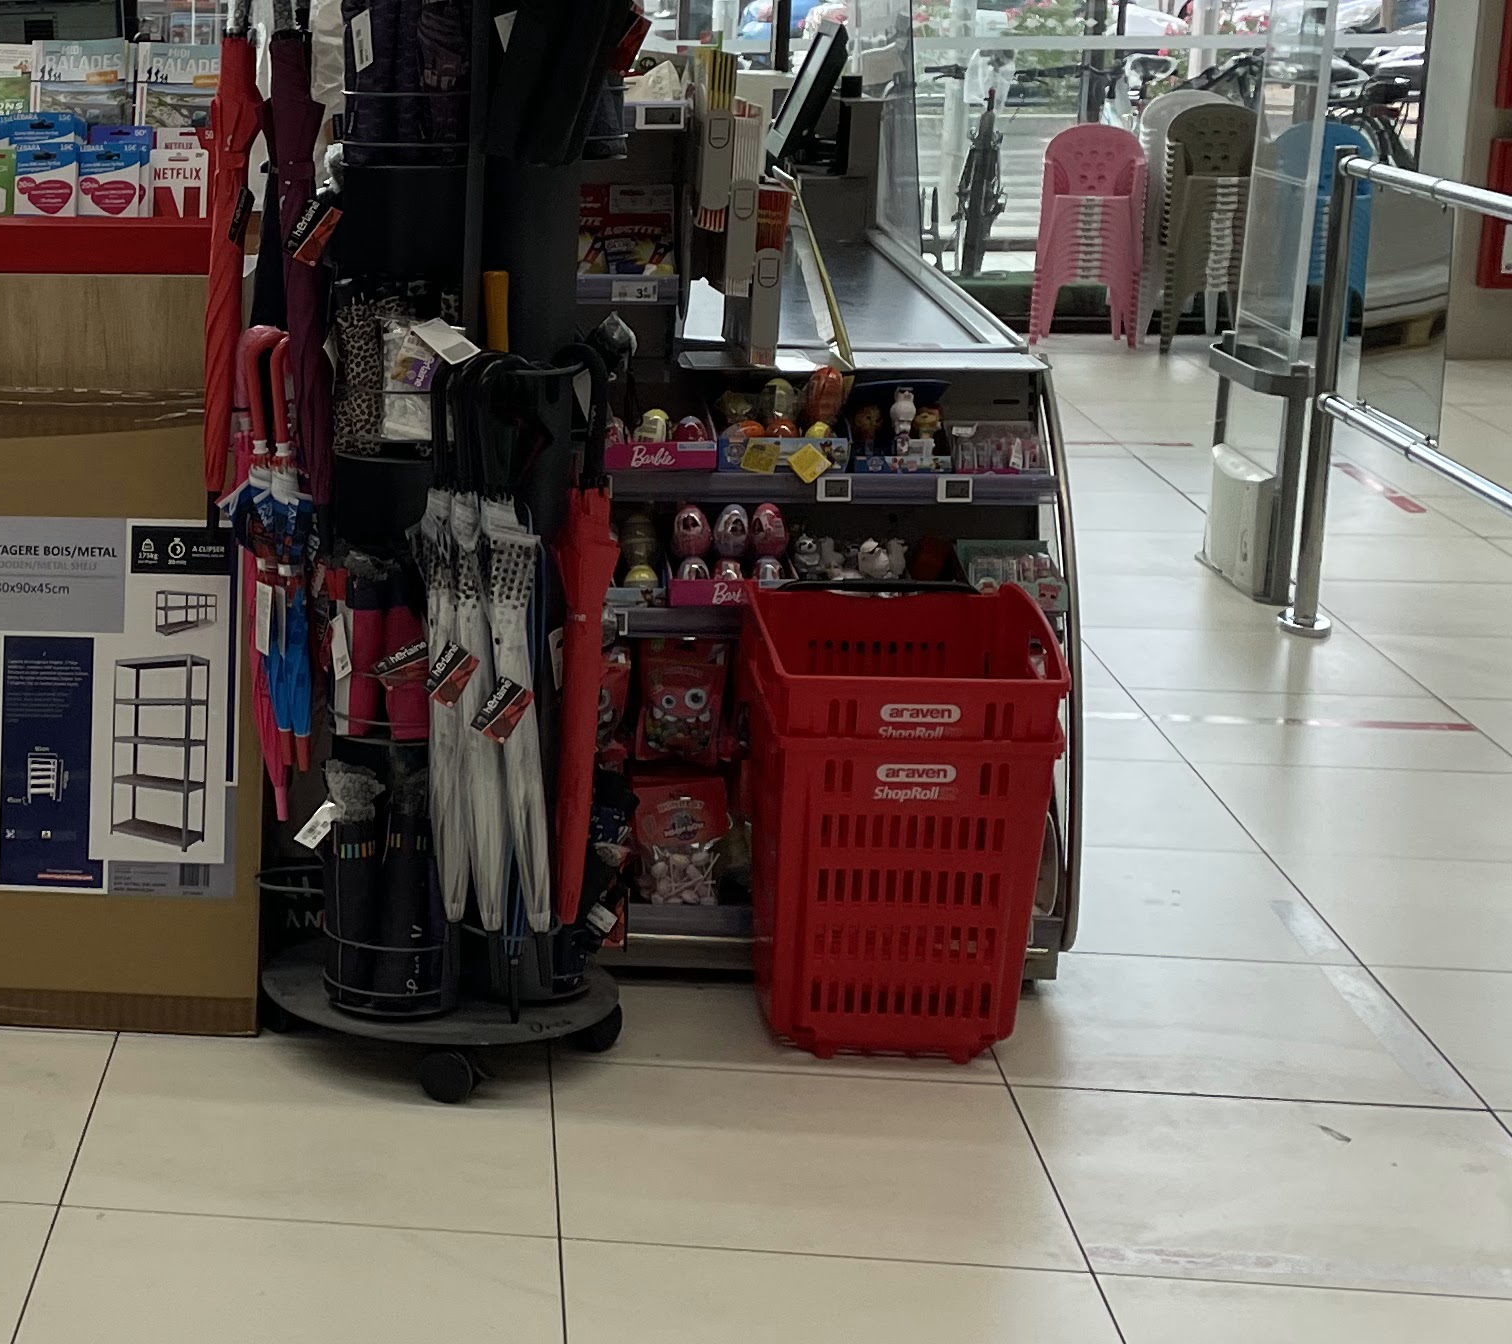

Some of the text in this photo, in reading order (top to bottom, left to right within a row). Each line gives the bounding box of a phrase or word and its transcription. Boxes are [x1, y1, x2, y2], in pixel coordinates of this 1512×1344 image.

[61, 45, 83, 55] MIDI
[167, 48, 190, 58] MIDI
[46, 53, 122, 72] BALADES
[152, 58, 219, 74] BALADE
[13, 113, 39, 122] LEBARA
[17, 144, 41, 152] LEBARA
[79, 144, 104, 152] LEBARA
[153, 167, 202, 181] NETFLIX
[604, 225, 664, 236] LOCTITE
[630, 445, 676, 467] Barbie
[44, 546, 117, 558] BOIS/METAL
[389, 641, 427, 664] herlaine
[431, 643, 459, 677] herlaine
[482, 679, 512, 714] herlaine
[889, 707, 953, 719] araven
[878, 725, 944, 738] ShopRoll
[885, 767, 948, 779] araven
[873, 785, 940, 803] ShopRoll
